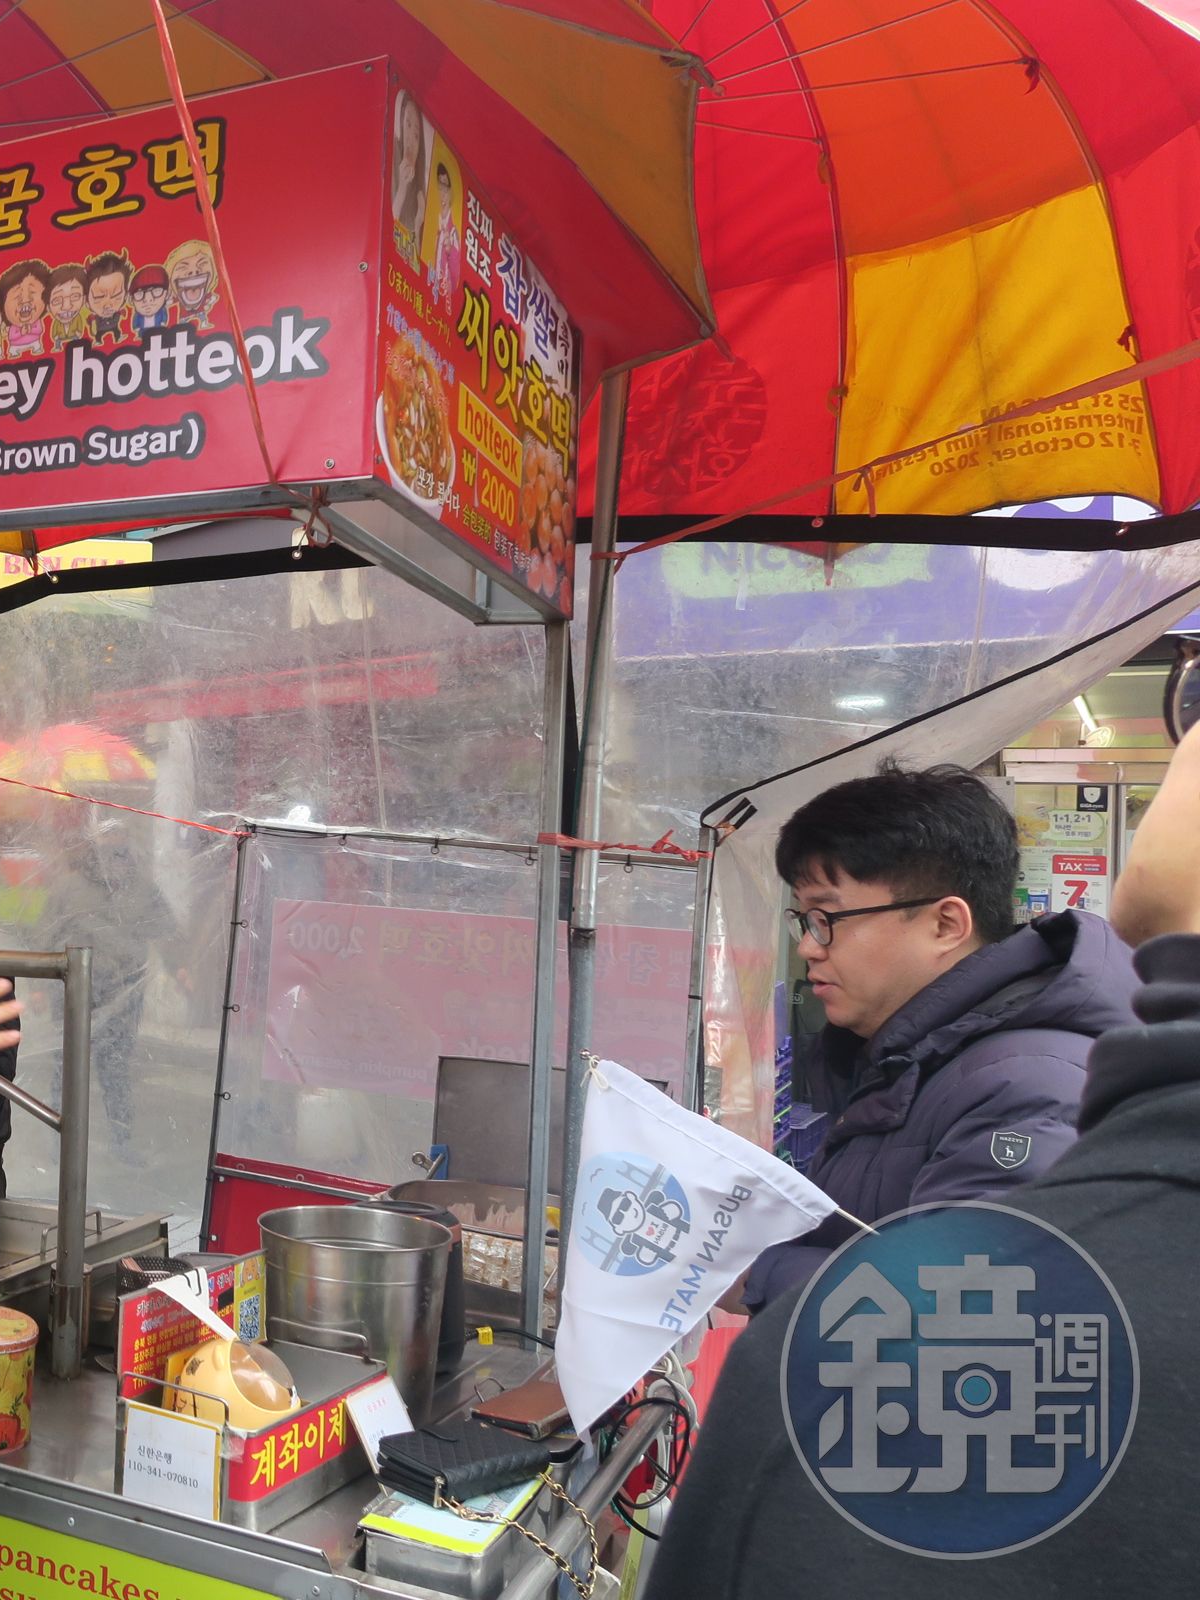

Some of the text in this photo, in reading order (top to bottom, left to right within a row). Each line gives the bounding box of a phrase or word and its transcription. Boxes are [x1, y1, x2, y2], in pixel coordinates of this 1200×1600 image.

[467, 190, 494, 251] 진짜
[465, 228, 492, 287] 원조
[497, 233, 556, 361] 찹쌀
[70, 313, 320, 402] hotteok
[457, 286, 572, 481] 씨앗호떡
[465, 391, 519, 477] hotteok
[417, 465, 436, 498] 포장
[482, 467, 516, 528] 2000
[1059, 862, 1082, 872] TAX
[136, 1444, 173, 1465] 신한은행
[249, 1397, 348, 1488] 계좌이체
[127, 1459, 199, 1489] 110-341-070810
